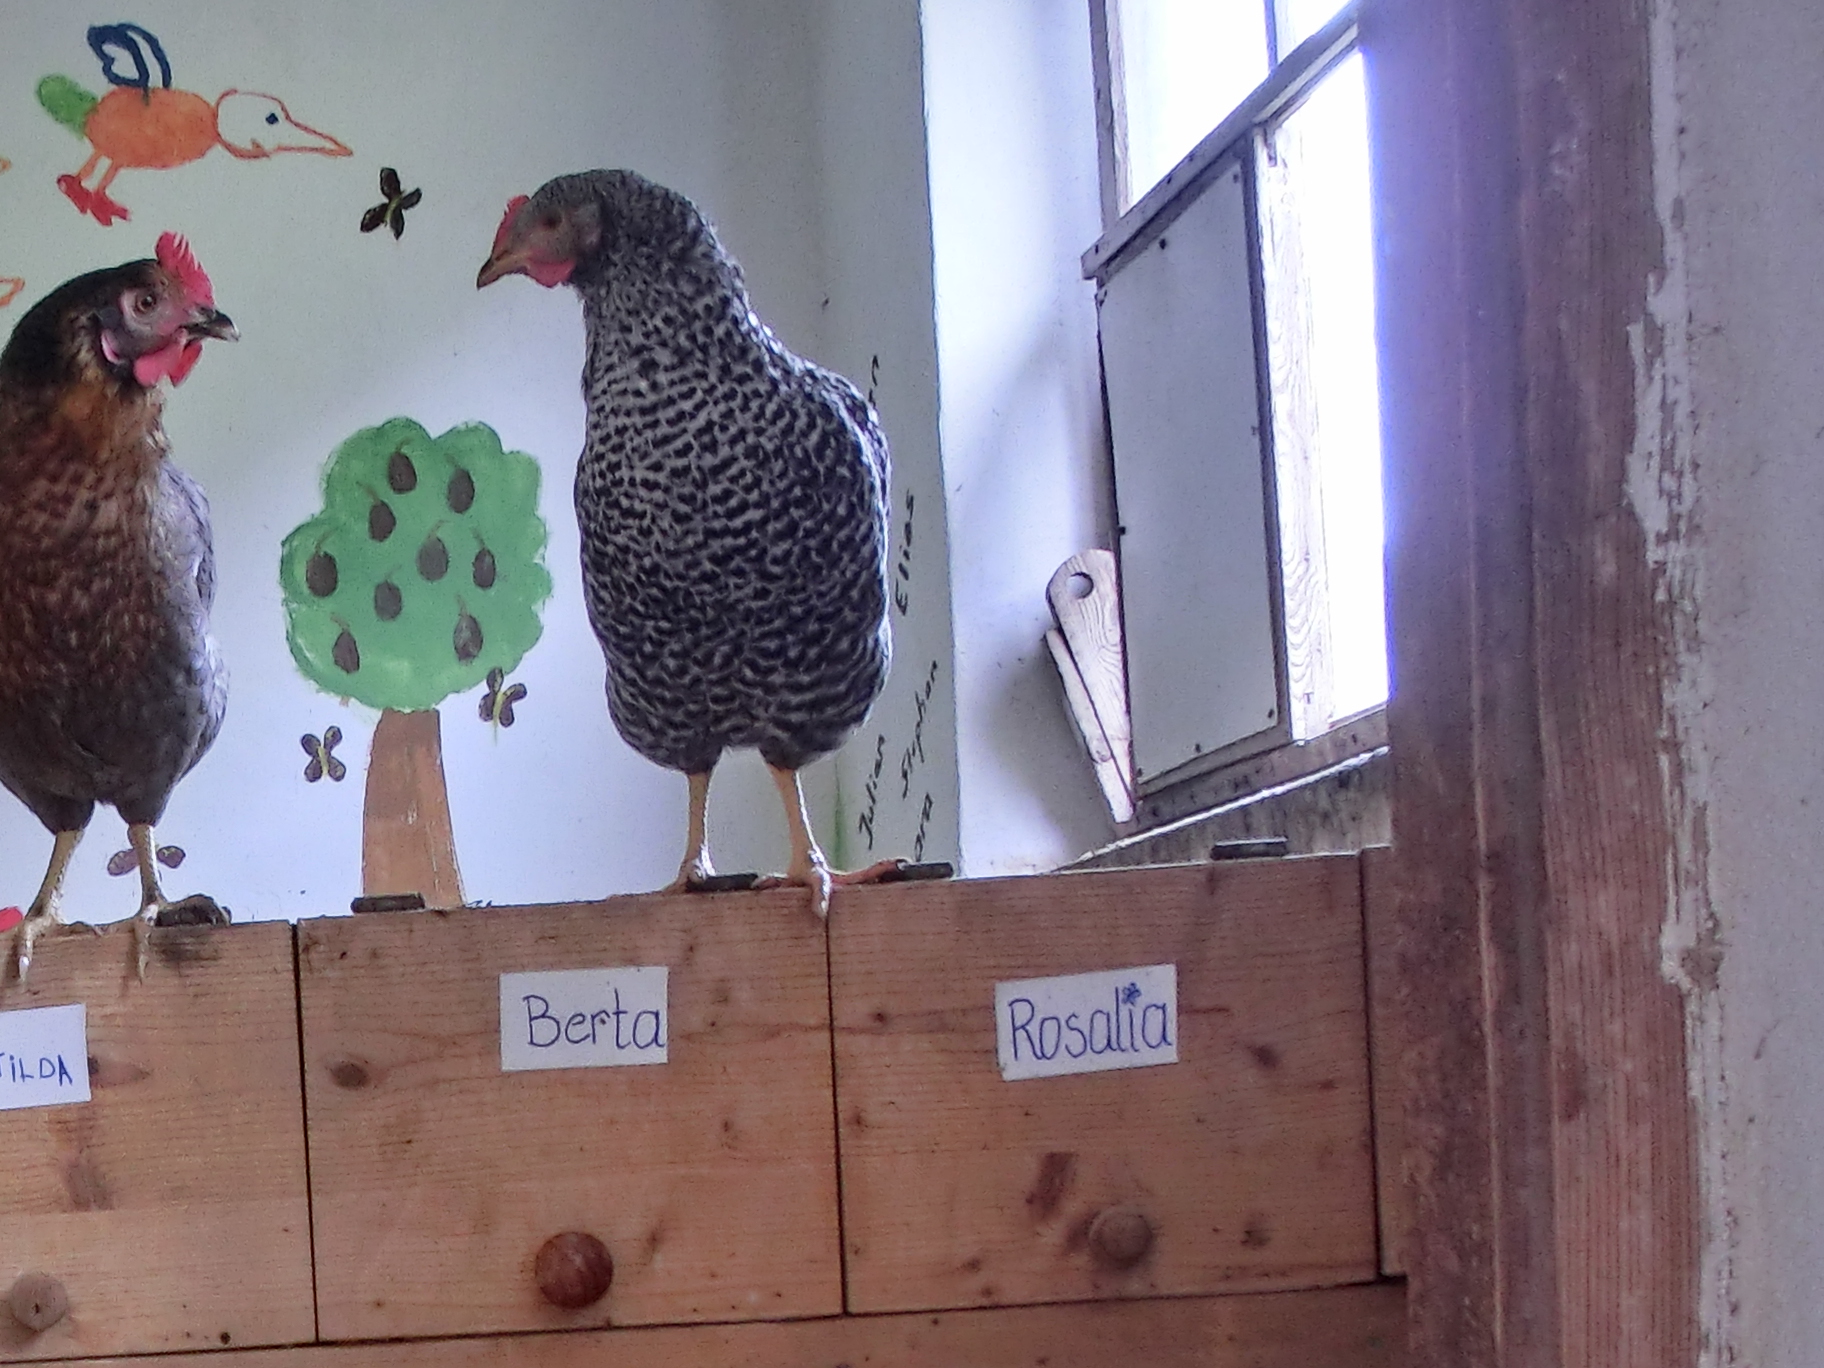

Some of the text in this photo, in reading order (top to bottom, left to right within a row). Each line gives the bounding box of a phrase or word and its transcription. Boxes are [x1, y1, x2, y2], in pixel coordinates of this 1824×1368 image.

[893, 489, 915, 617] Elias
[858, 734, 886, 851] Julian
[521, 988, 667, 1050] Berta
[1007, 984, 1172, 1061] Rosalia
